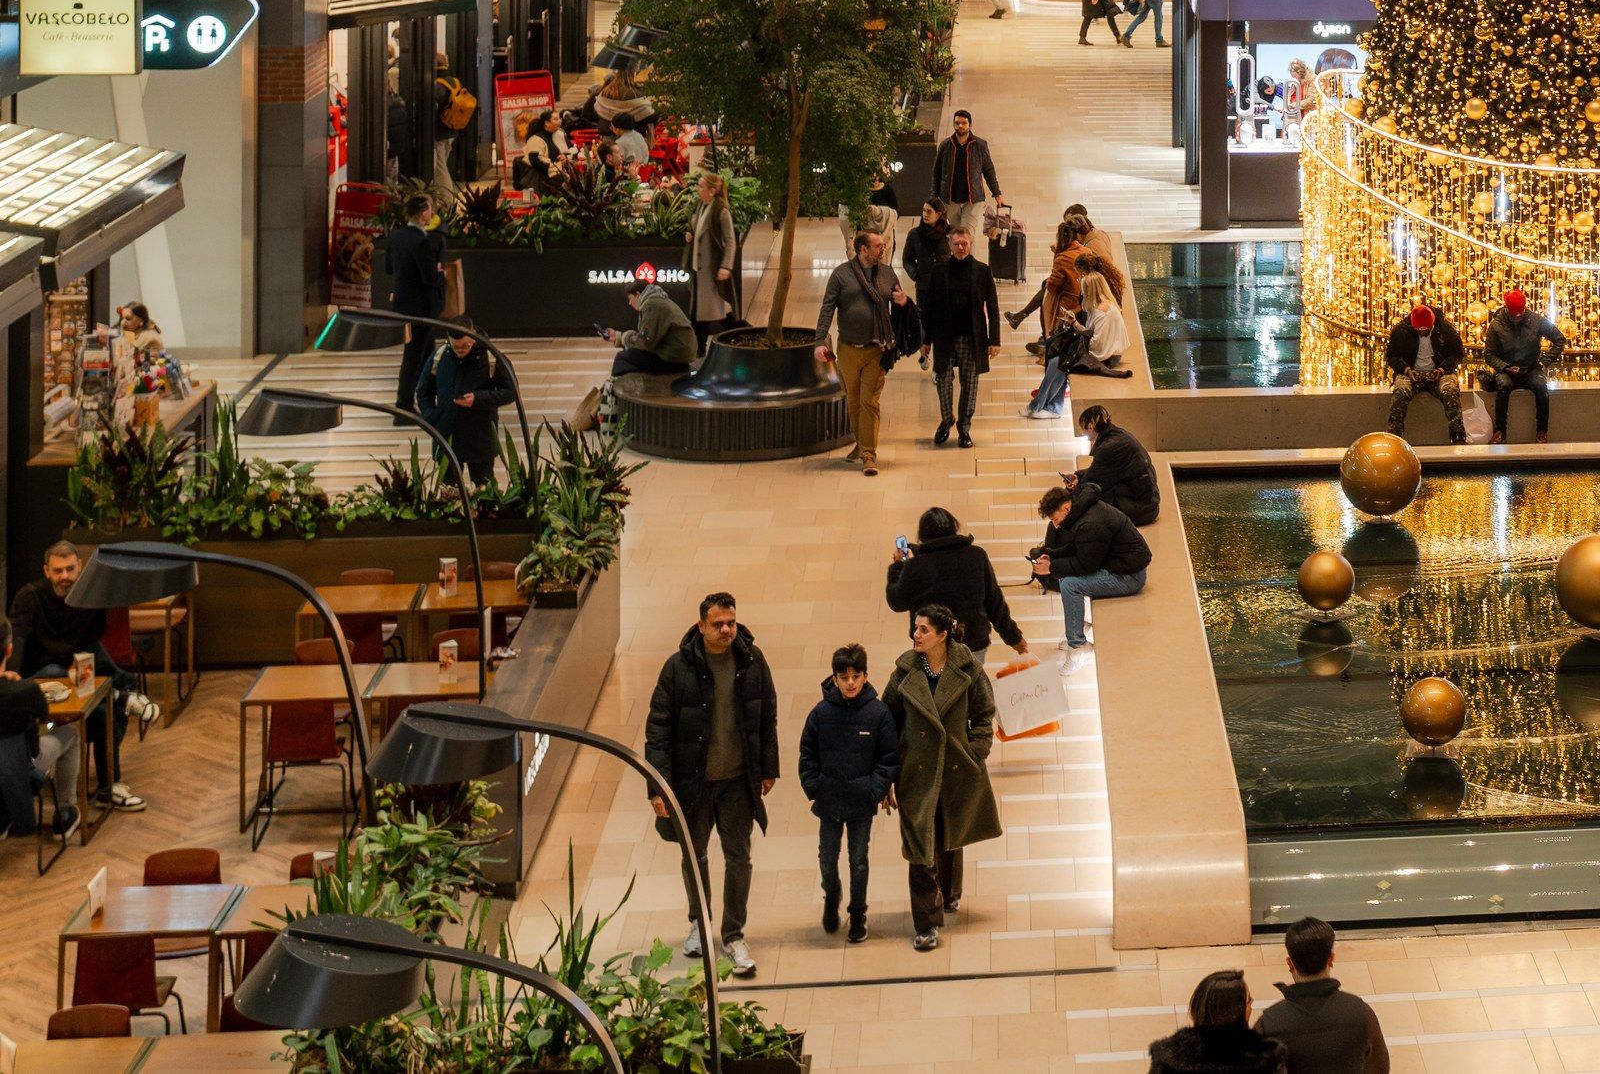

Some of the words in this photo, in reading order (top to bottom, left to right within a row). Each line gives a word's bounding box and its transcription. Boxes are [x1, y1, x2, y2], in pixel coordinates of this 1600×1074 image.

[26, 12, 130, 26] VASCOBELO
[1312, 21, 1351, 37] dyson
[588, 269, 635, 283] SALSA
